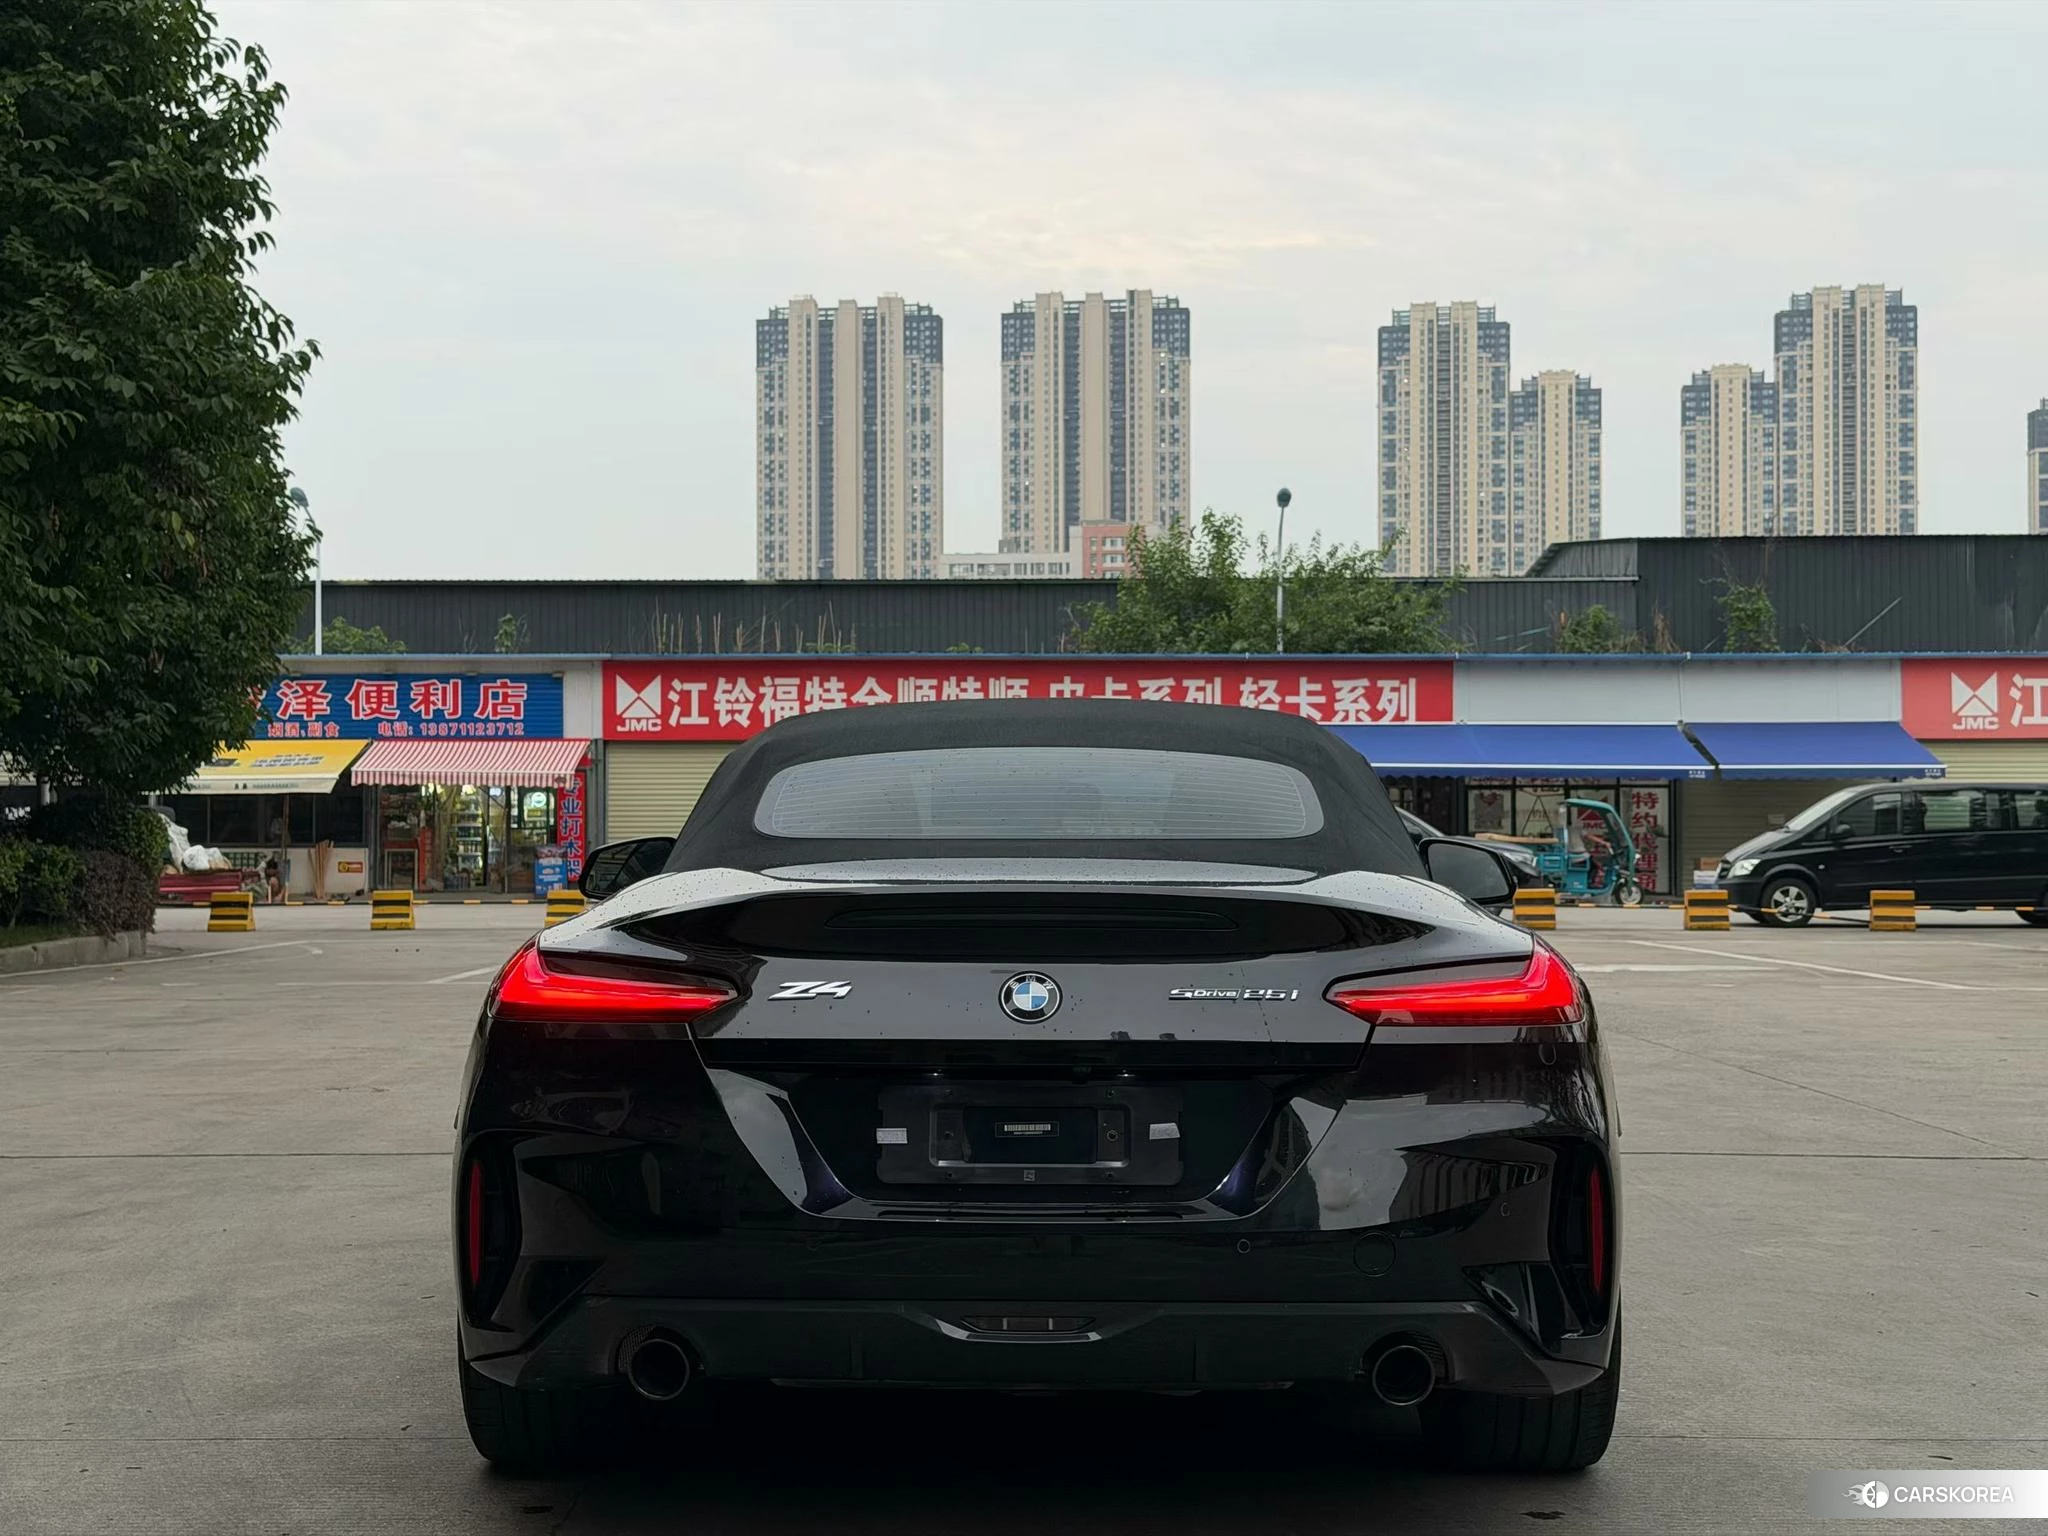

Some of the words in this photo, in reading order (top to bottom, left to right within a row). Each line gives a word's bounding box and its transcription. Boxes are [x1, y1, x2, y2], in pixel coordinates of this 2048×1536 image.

[1239, 676, 1416, 724] 轻卡系列
[616, 719, 662, 732] JMC
[1952, 716, 1999, 731] JMC
[767, 980, 853, 1001] Z4
